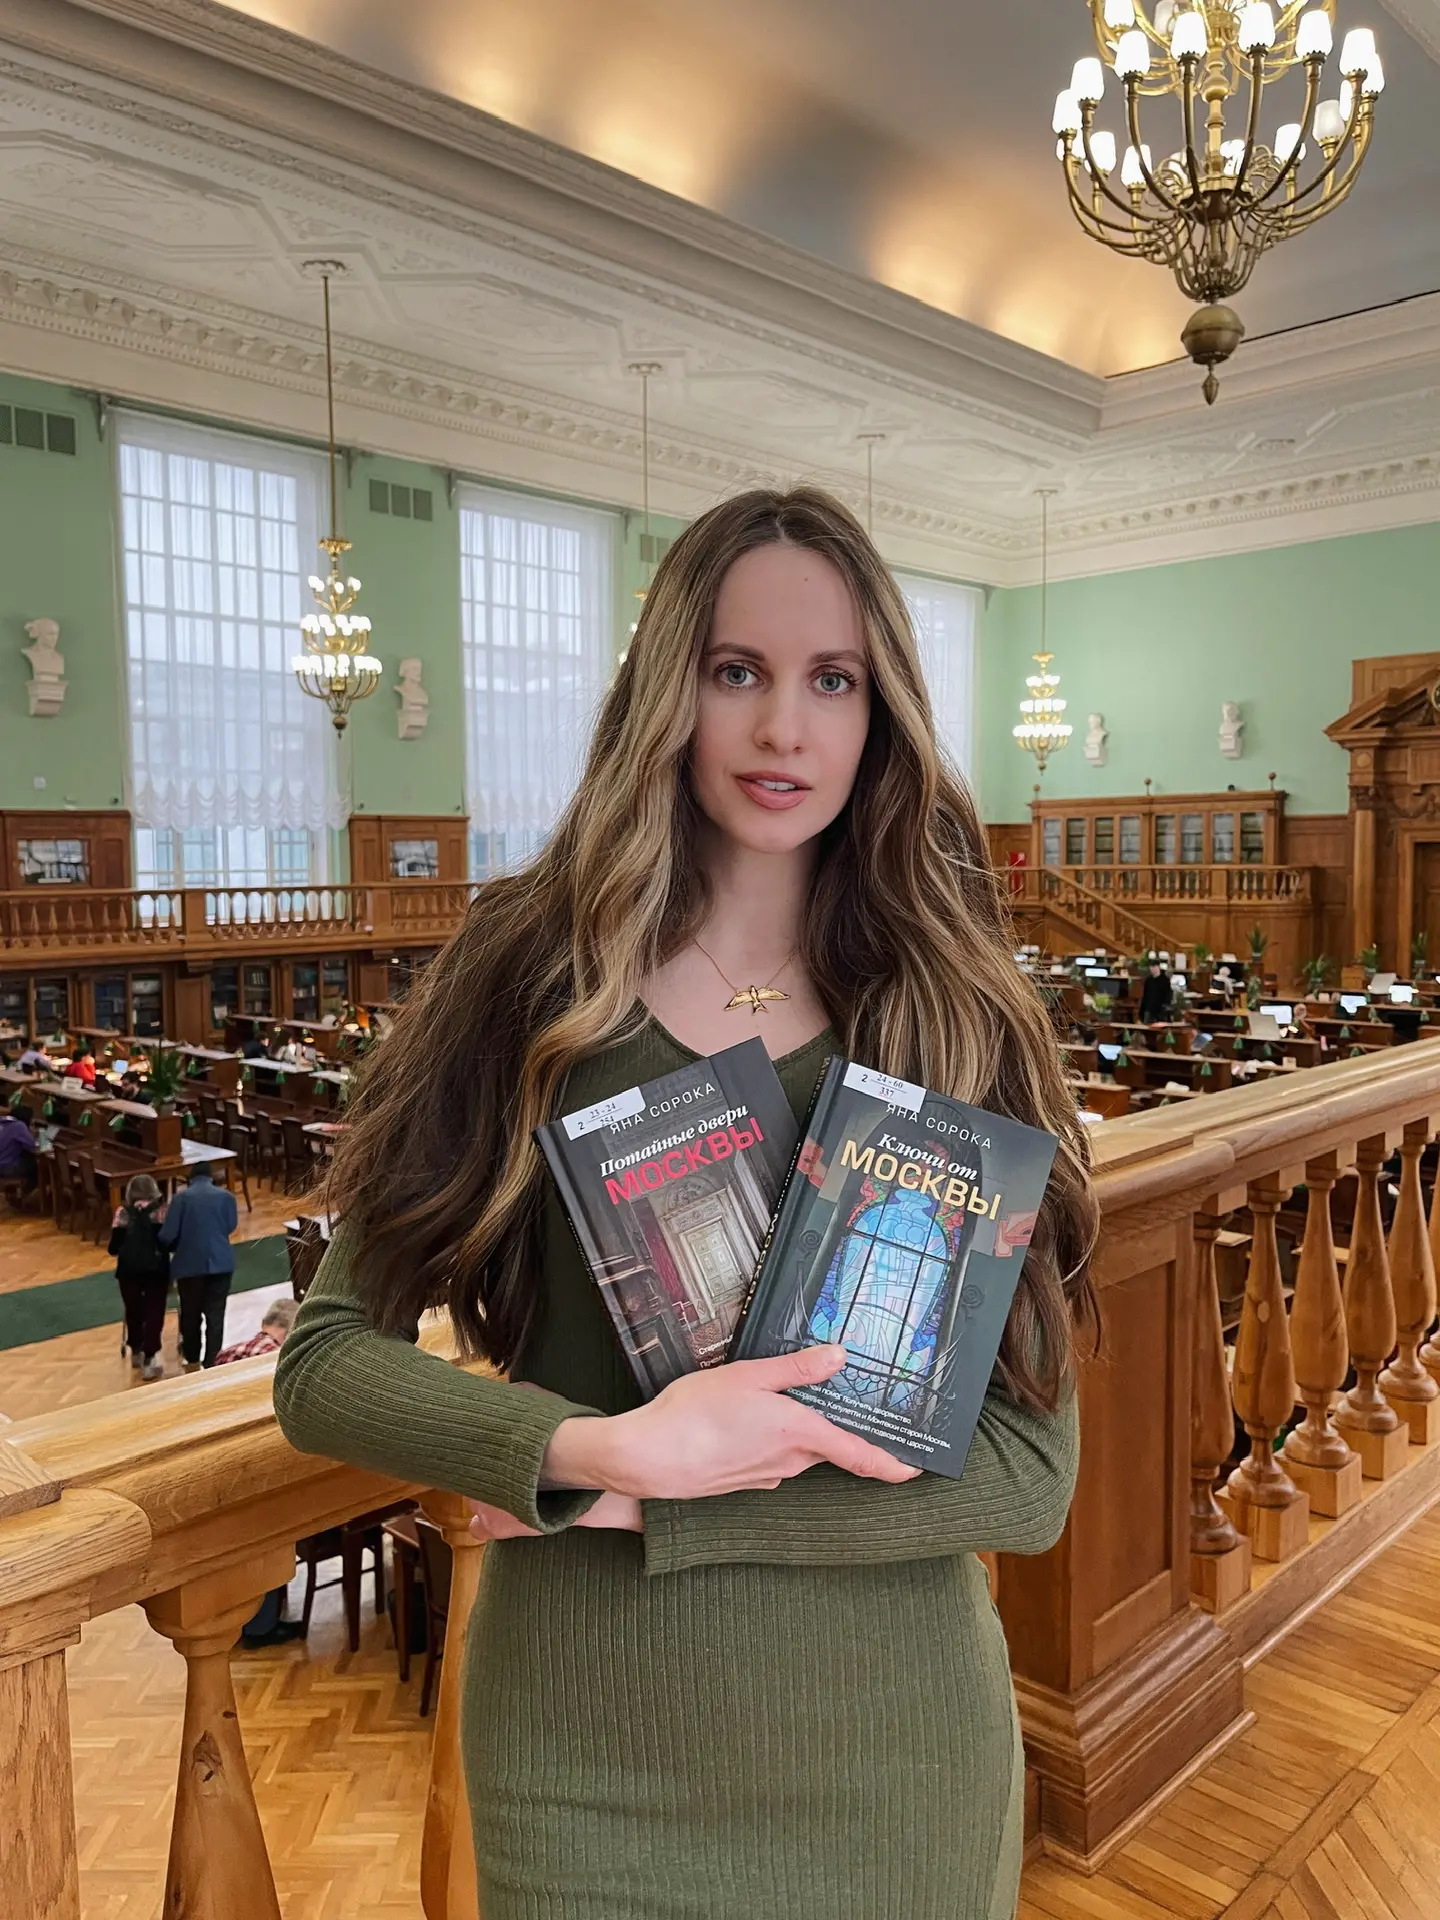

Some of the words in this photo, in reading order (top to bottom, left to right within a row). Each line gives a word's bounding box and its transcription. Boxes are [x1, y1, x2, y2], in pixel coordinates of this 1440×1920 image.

[861, 1074, 868, 1083] 2
[577, 1121, 585, 1131] 2
[610, 1113, 644, 1135] ЯНА
[650, 1082, 715, 1118] СОРОКА
[885, 1103, 918, 1123] ЯНА
[926, 1117, 991, 1149] СОРОКА
[600, 1128, 695, 1177] Потайные
[698, 1105, 749, 1135] двери
[604, 1117, 764, 1205] МОСКВЫ
[877, 1133, 945, 1169] Ключи
[948, 1162, 978, 1181] от
[840, 1139, 1002, 1220] МОСКВЫ
[870, 1428, 906, 1444] подводное
[906, 1440, 935, 1454] царство
[899, 1426, 924, 1439] старой
